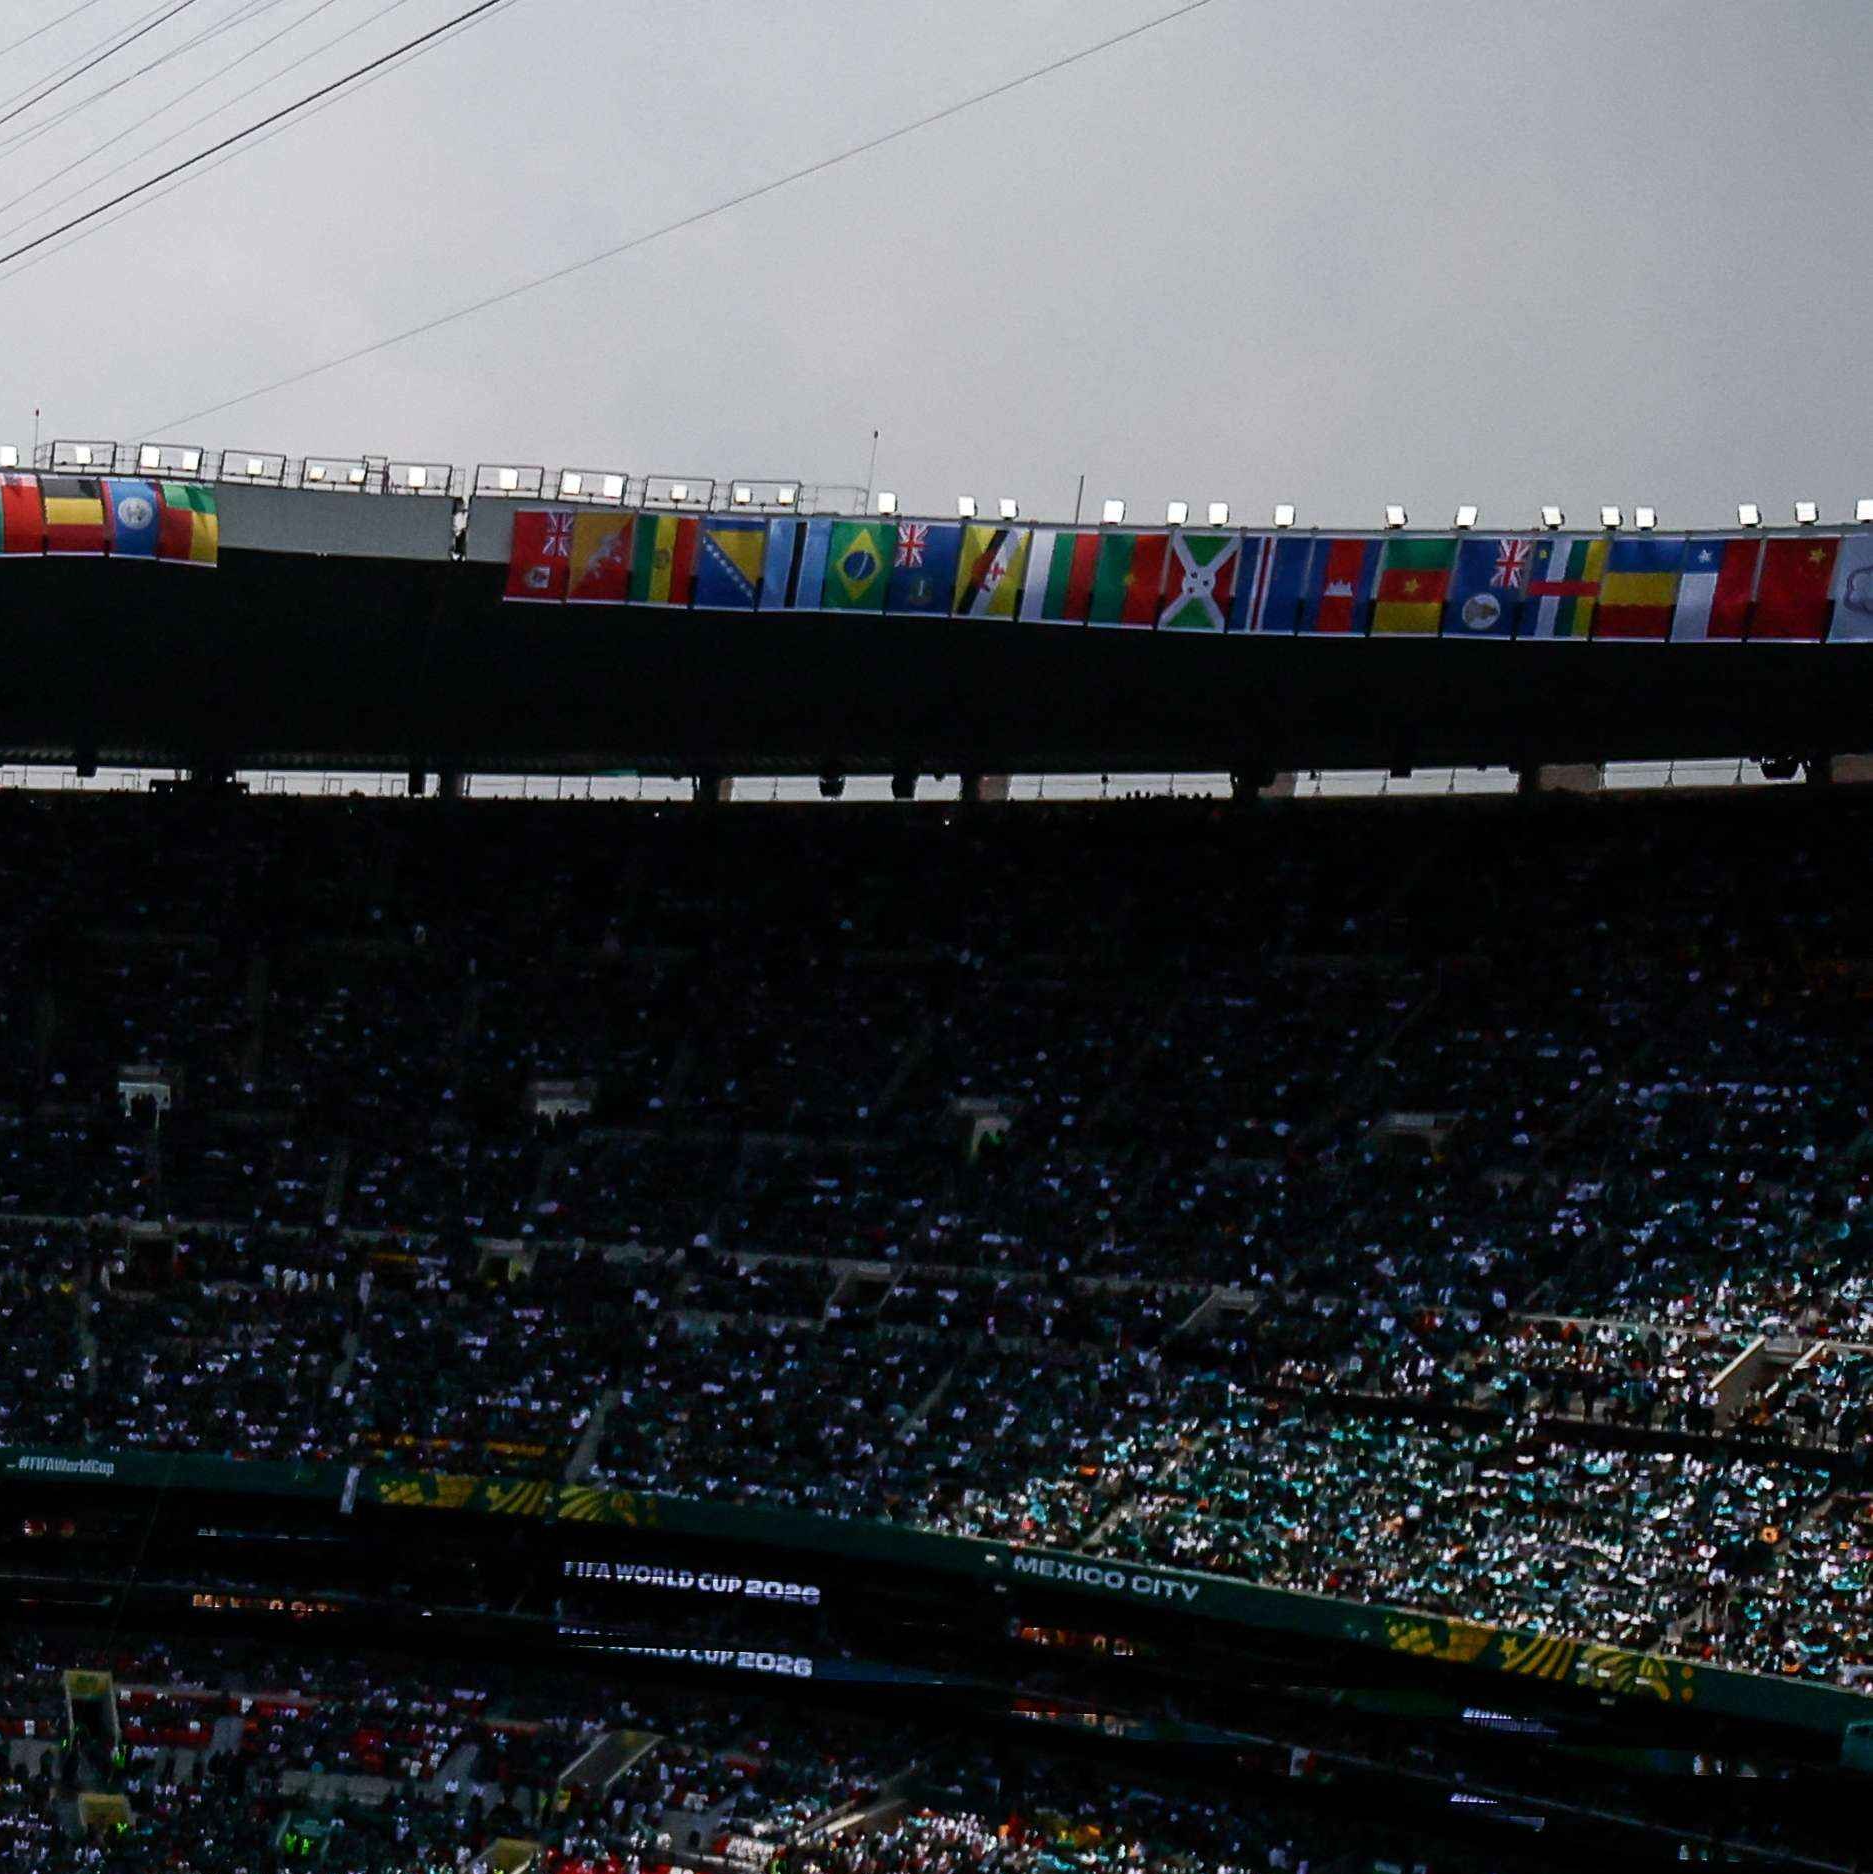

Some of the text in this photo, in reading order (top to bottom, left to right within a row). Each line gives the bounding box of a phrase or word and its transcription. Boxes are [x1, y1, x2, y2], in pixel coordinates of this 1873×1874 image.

[563, 1560, 822, 1608] FIFA WORLD CUP 2026
[1013, 1554, 1201, 1602] MEXICO CITY
[737, 1652, 814, 1679] 2026
